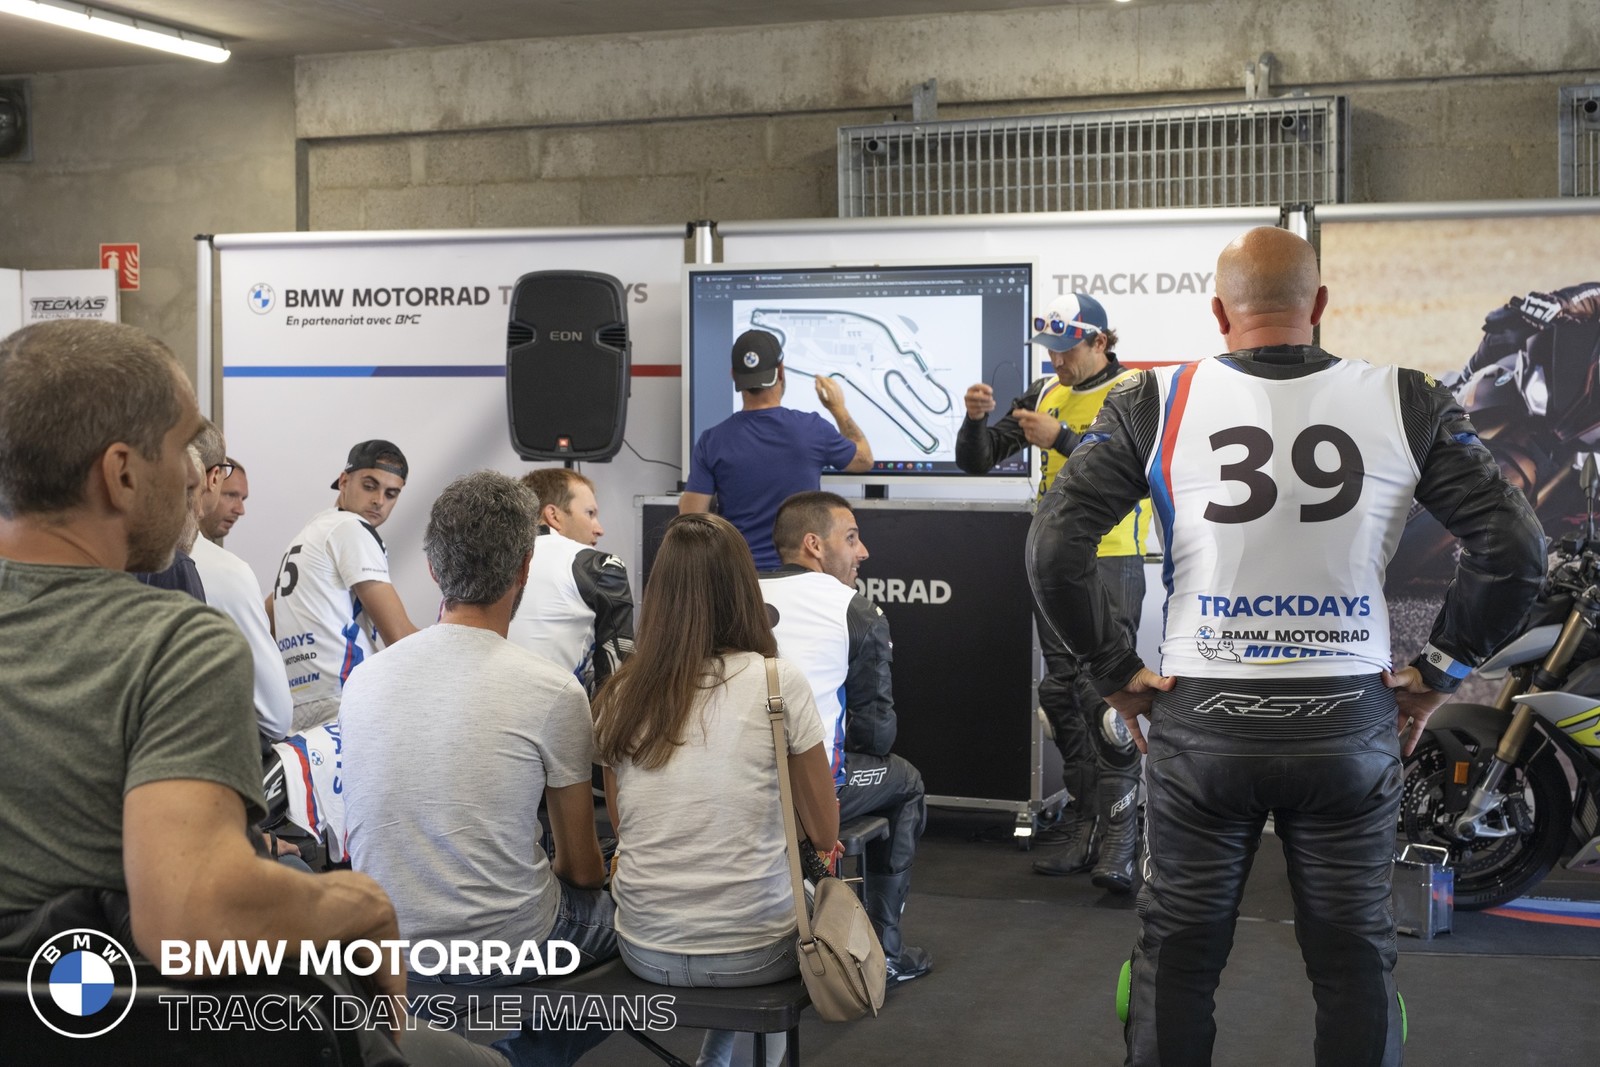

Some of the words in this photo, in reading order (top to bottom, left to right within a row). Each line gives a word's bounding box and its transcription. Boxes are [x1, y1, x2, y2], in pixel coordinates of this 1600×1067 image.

[1052, 273, 1149, 295] TRACK
[1156, 272, 1217, 294] DAY
[31, 297, 107, 312] TECMAS
[285, 289, 344, 307] BMW
[352, 286, 490, 307] MOTORRAD
[286, 316, 299, 326] En
[302, 315, 364, 328] partenariat
[366, 317, 391, 325] avec
[395, 314, 421, 325] BMC
[550, 331, 582, 341] EON
[1203, 424, 1365, 524] 39
[1198, 595, 1370, 617] TRACKDAYS
[278, 632, 316, 652] CKDAYS
[1222, 630, 1269, 640] BMW
[1275, 629, 1370, 643] MOTORRAD
[289, 672, 320, 688] ICHELIN
[1193, 690, 1365, 718] RST
[849, 767, 887, 786] RST
[1111, 784, 1138, 818] RST
